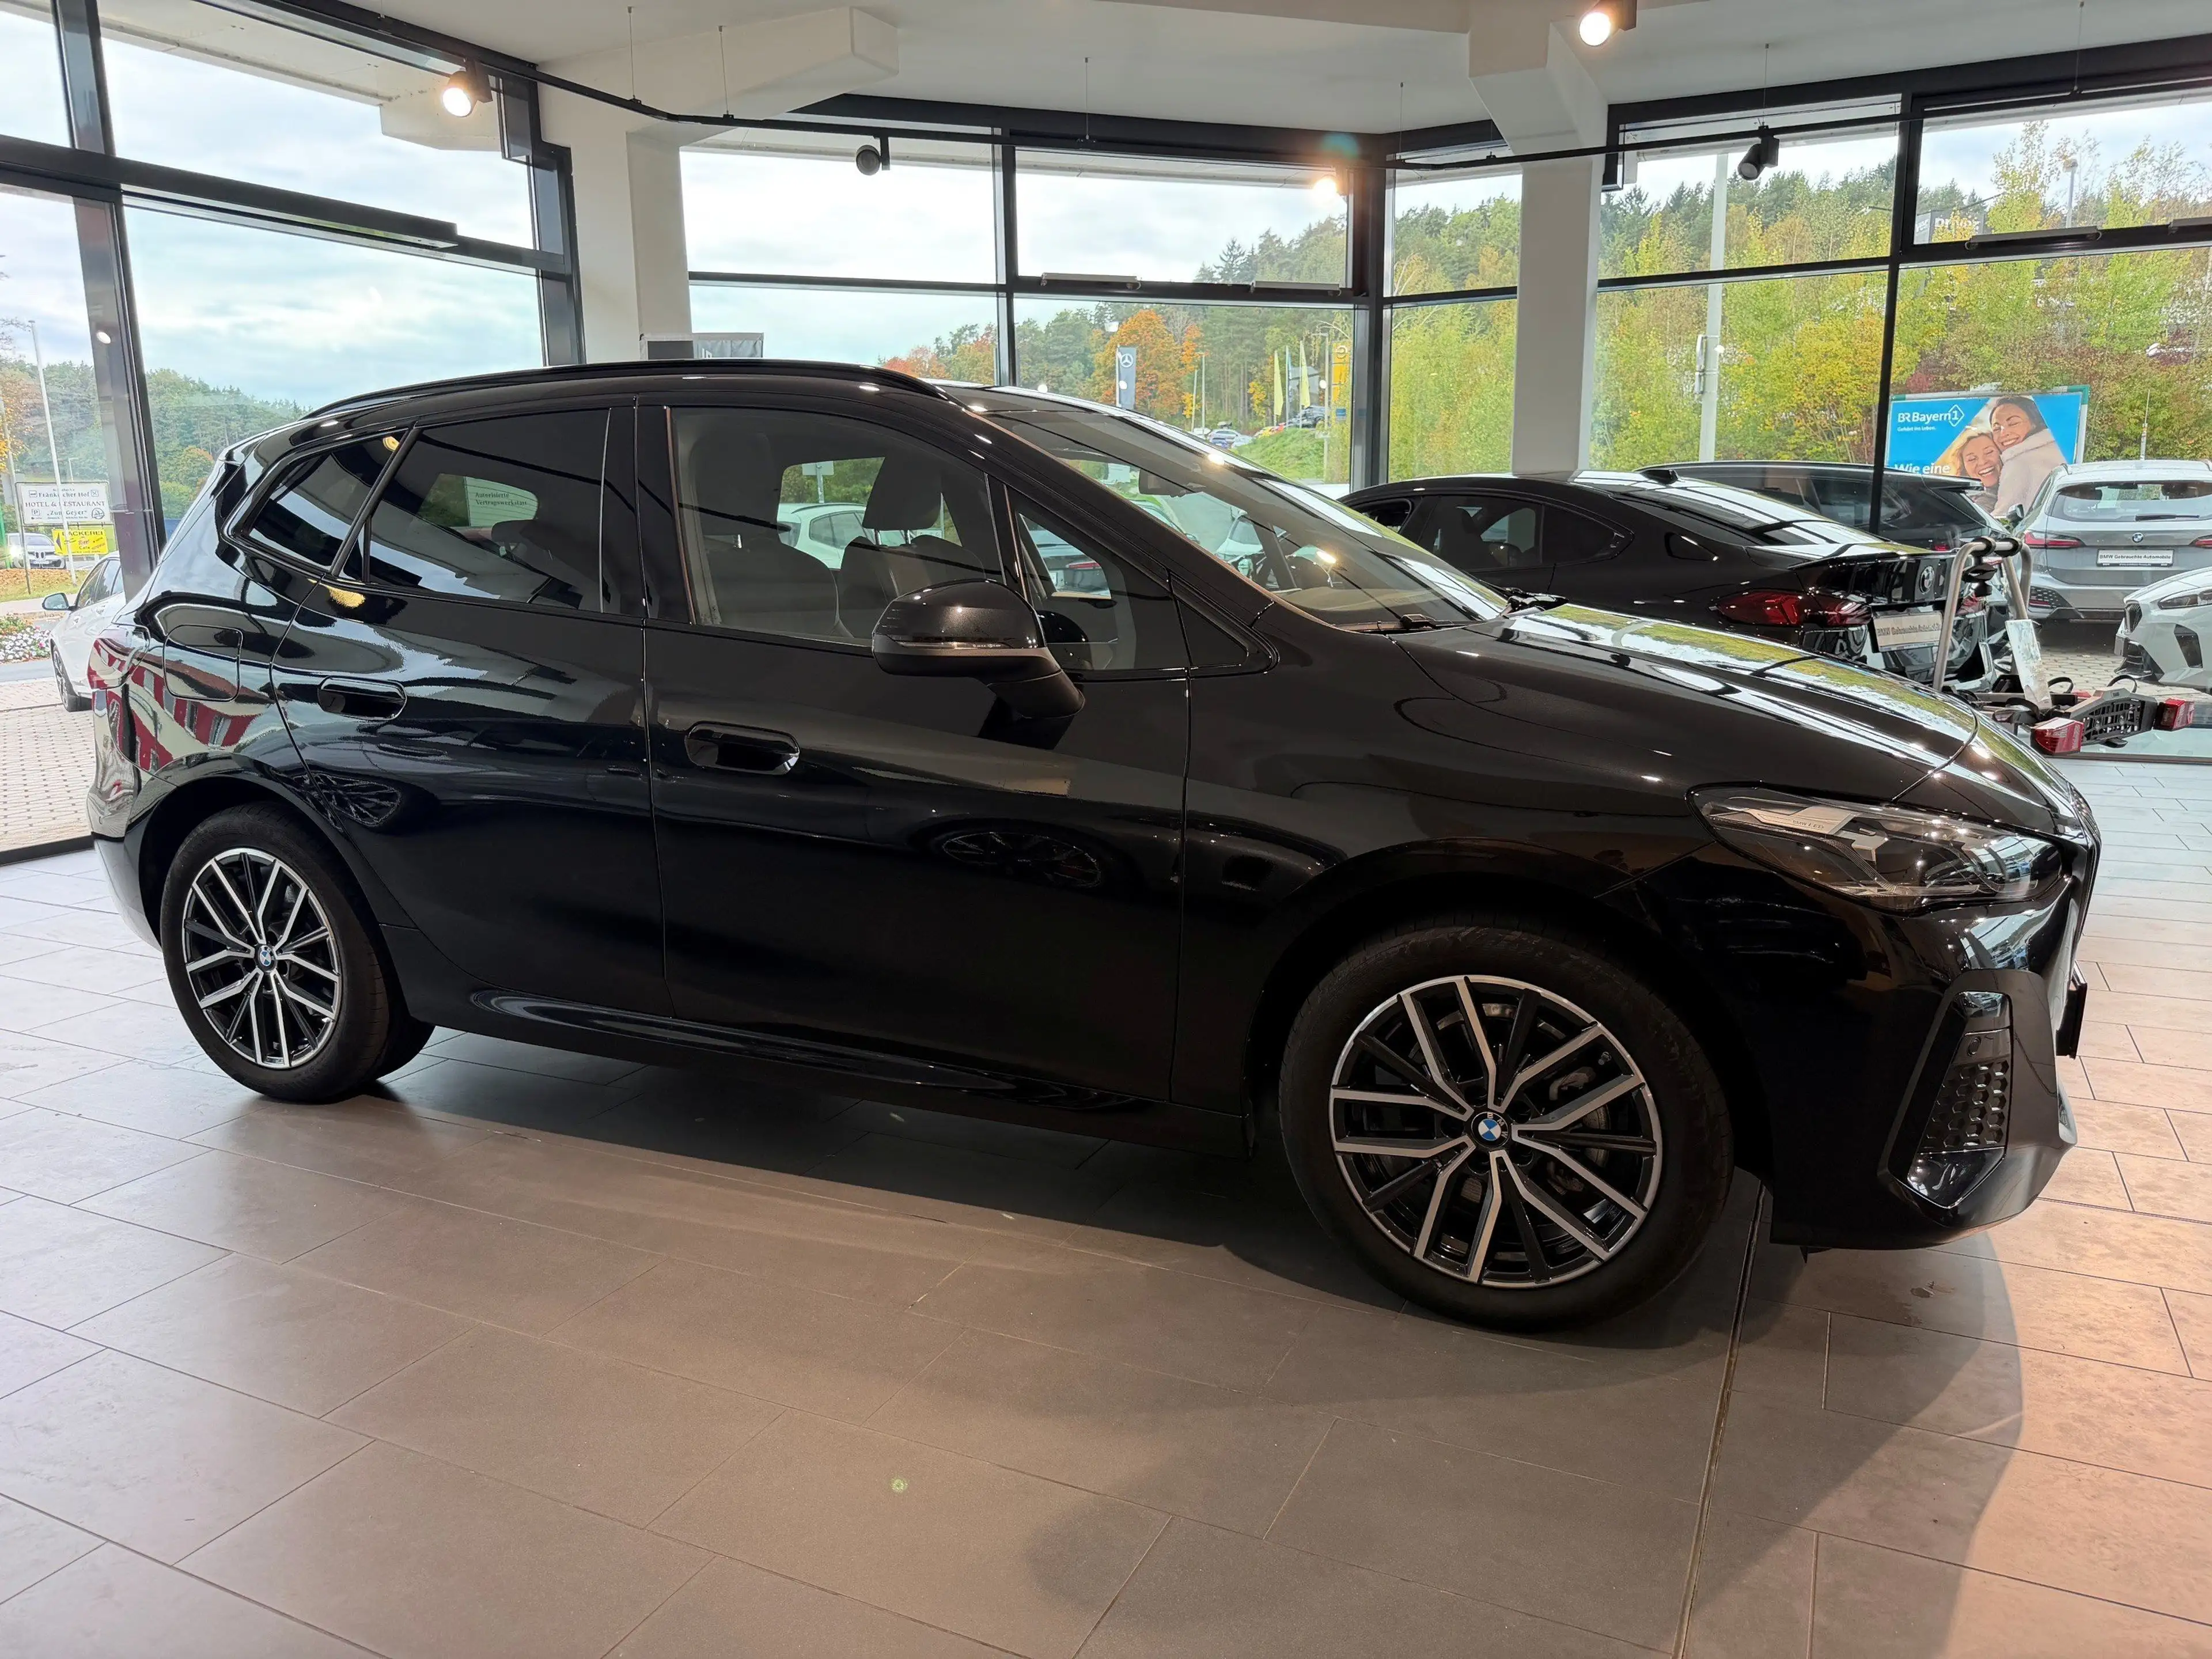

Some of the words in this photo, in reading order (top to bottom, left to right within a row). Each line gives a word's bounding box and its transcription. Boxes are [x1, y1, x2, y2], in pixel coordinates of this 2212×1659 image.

[1912, 412, 1951, 425] Bayern
[1894, 463, 1920, 474] Wie
[1922, 463, 1950, 474] eine
